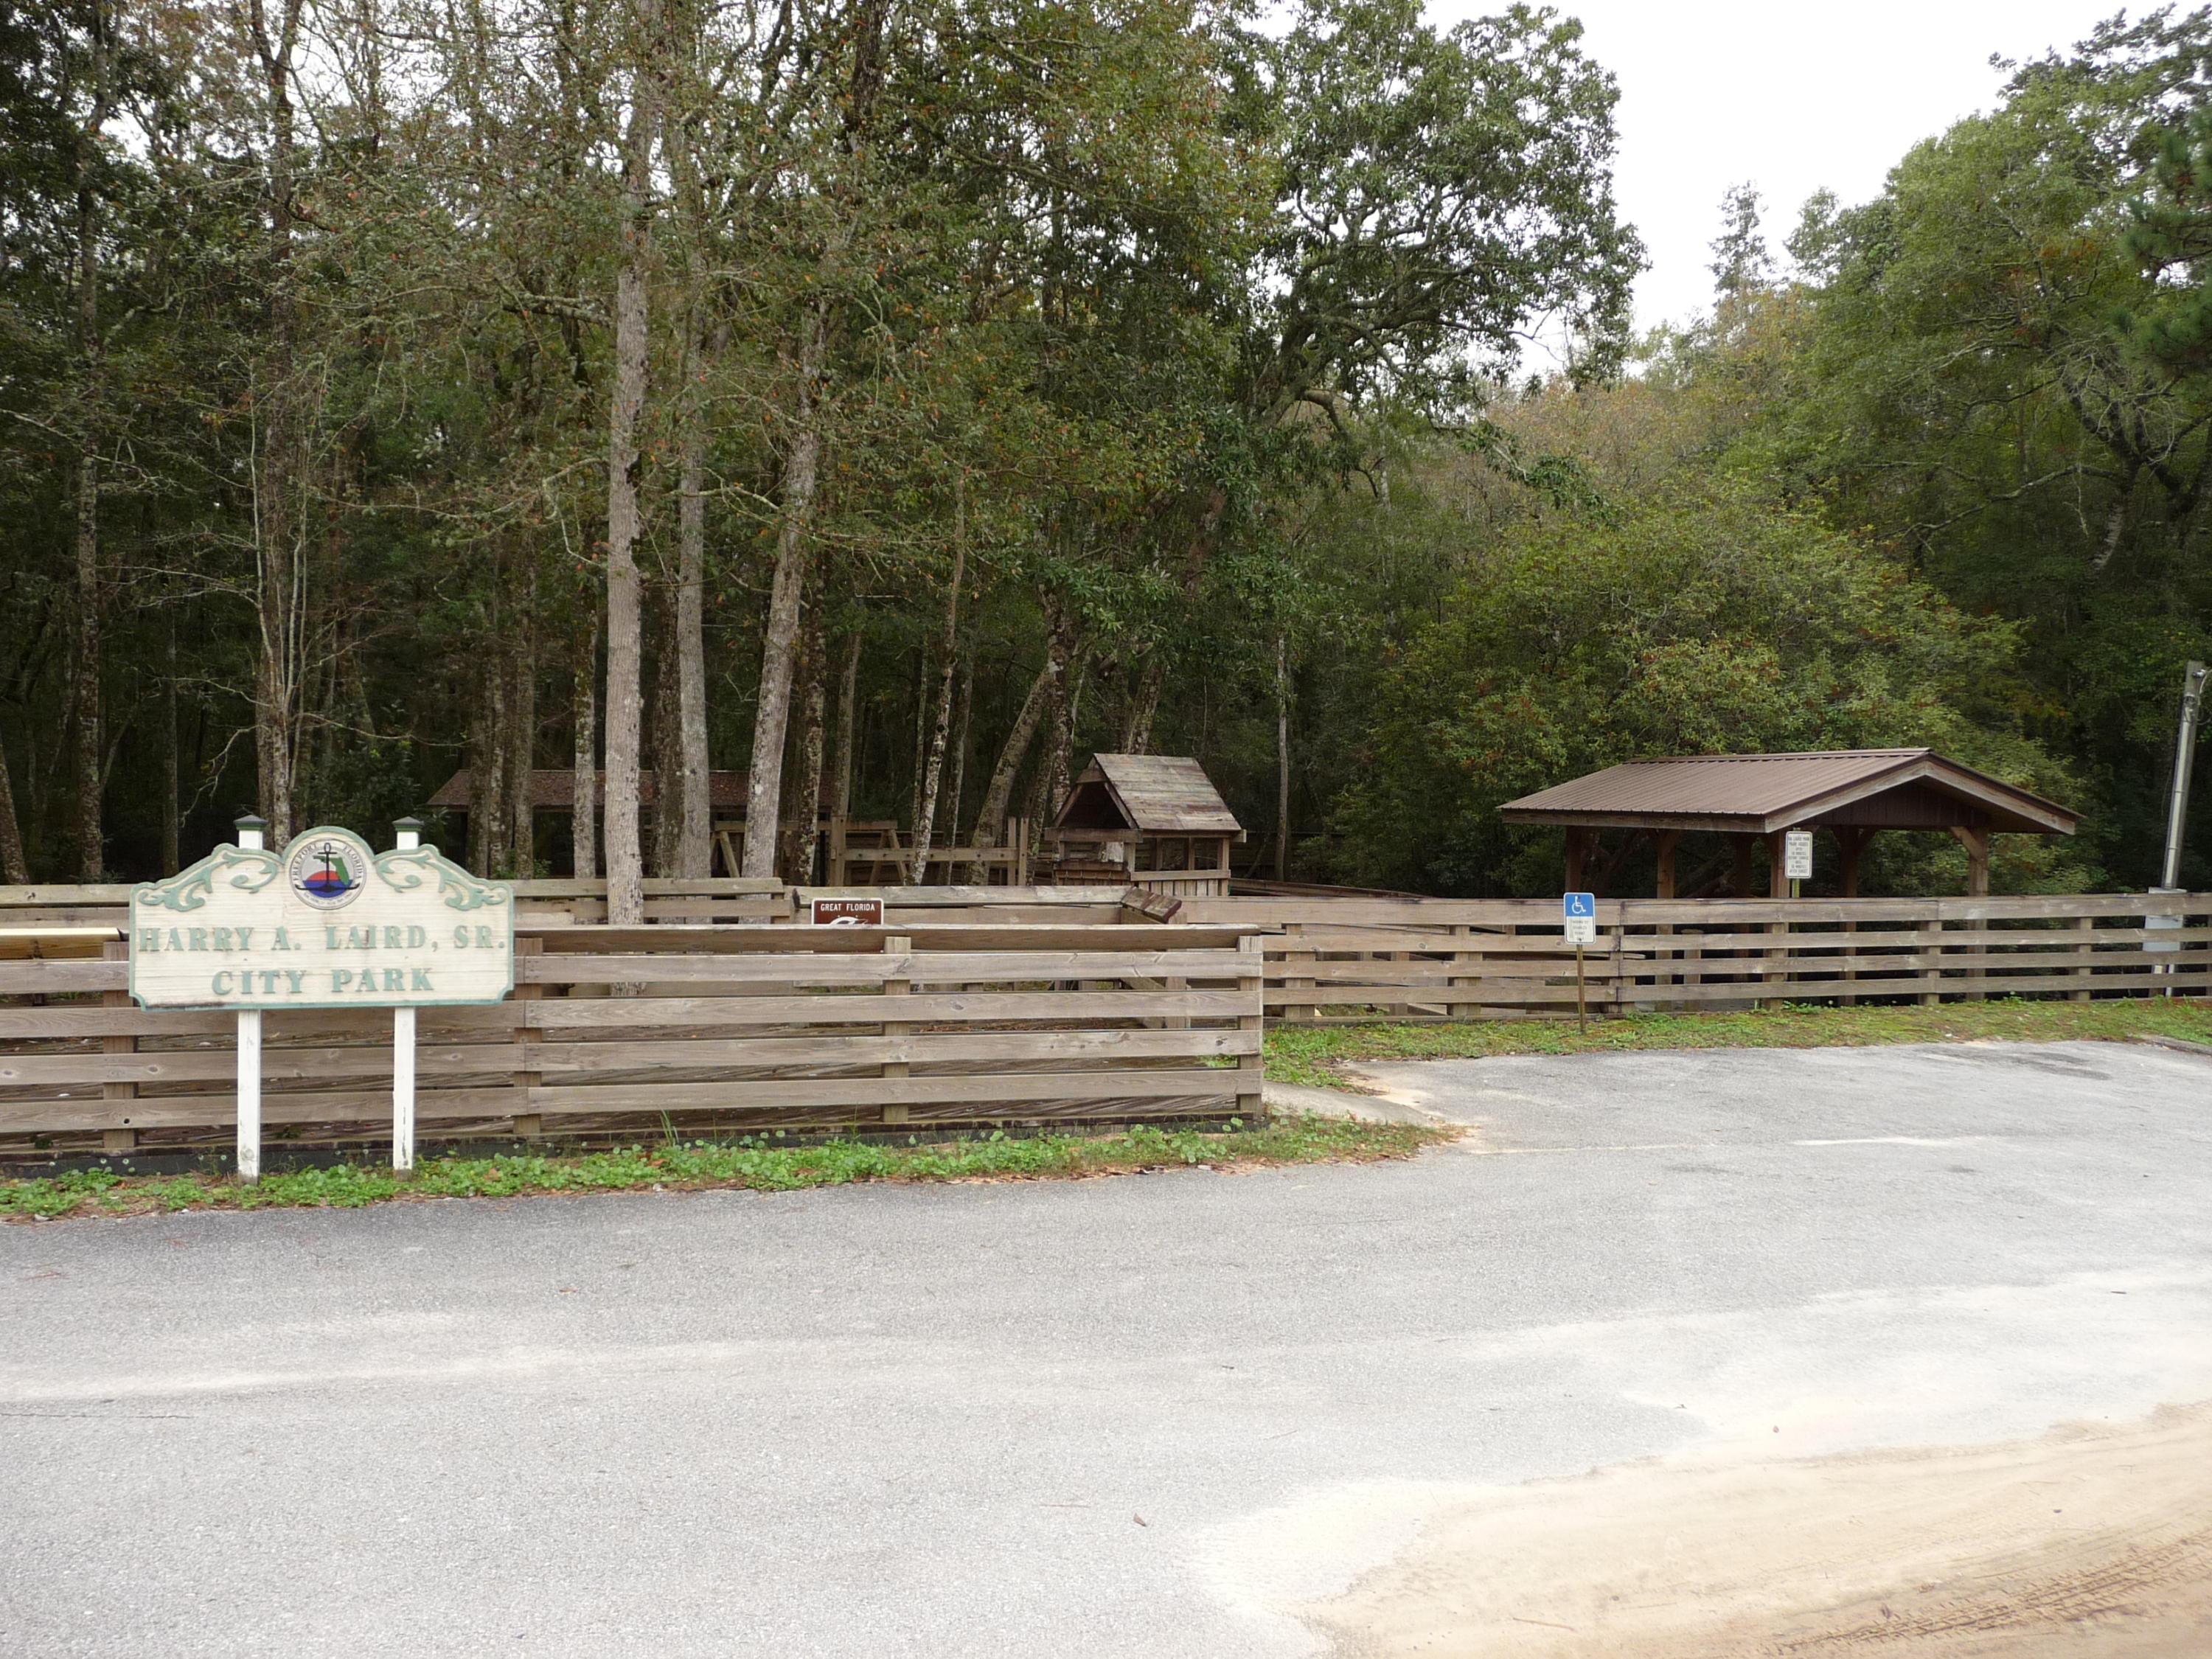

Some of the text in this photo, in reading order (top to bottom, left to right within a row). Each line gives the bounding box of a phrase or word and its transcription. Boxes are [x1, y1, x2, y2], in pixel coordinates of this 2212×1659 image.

[292, 843, 364, 881] FREEPORT FLORIDA
[820, 903, 875, 911] GREAT FLORIDA
[139, 924, 505, 952] HARRY A. LAIRD, SR.
[211, 967, 435, 995] CITY PARK
